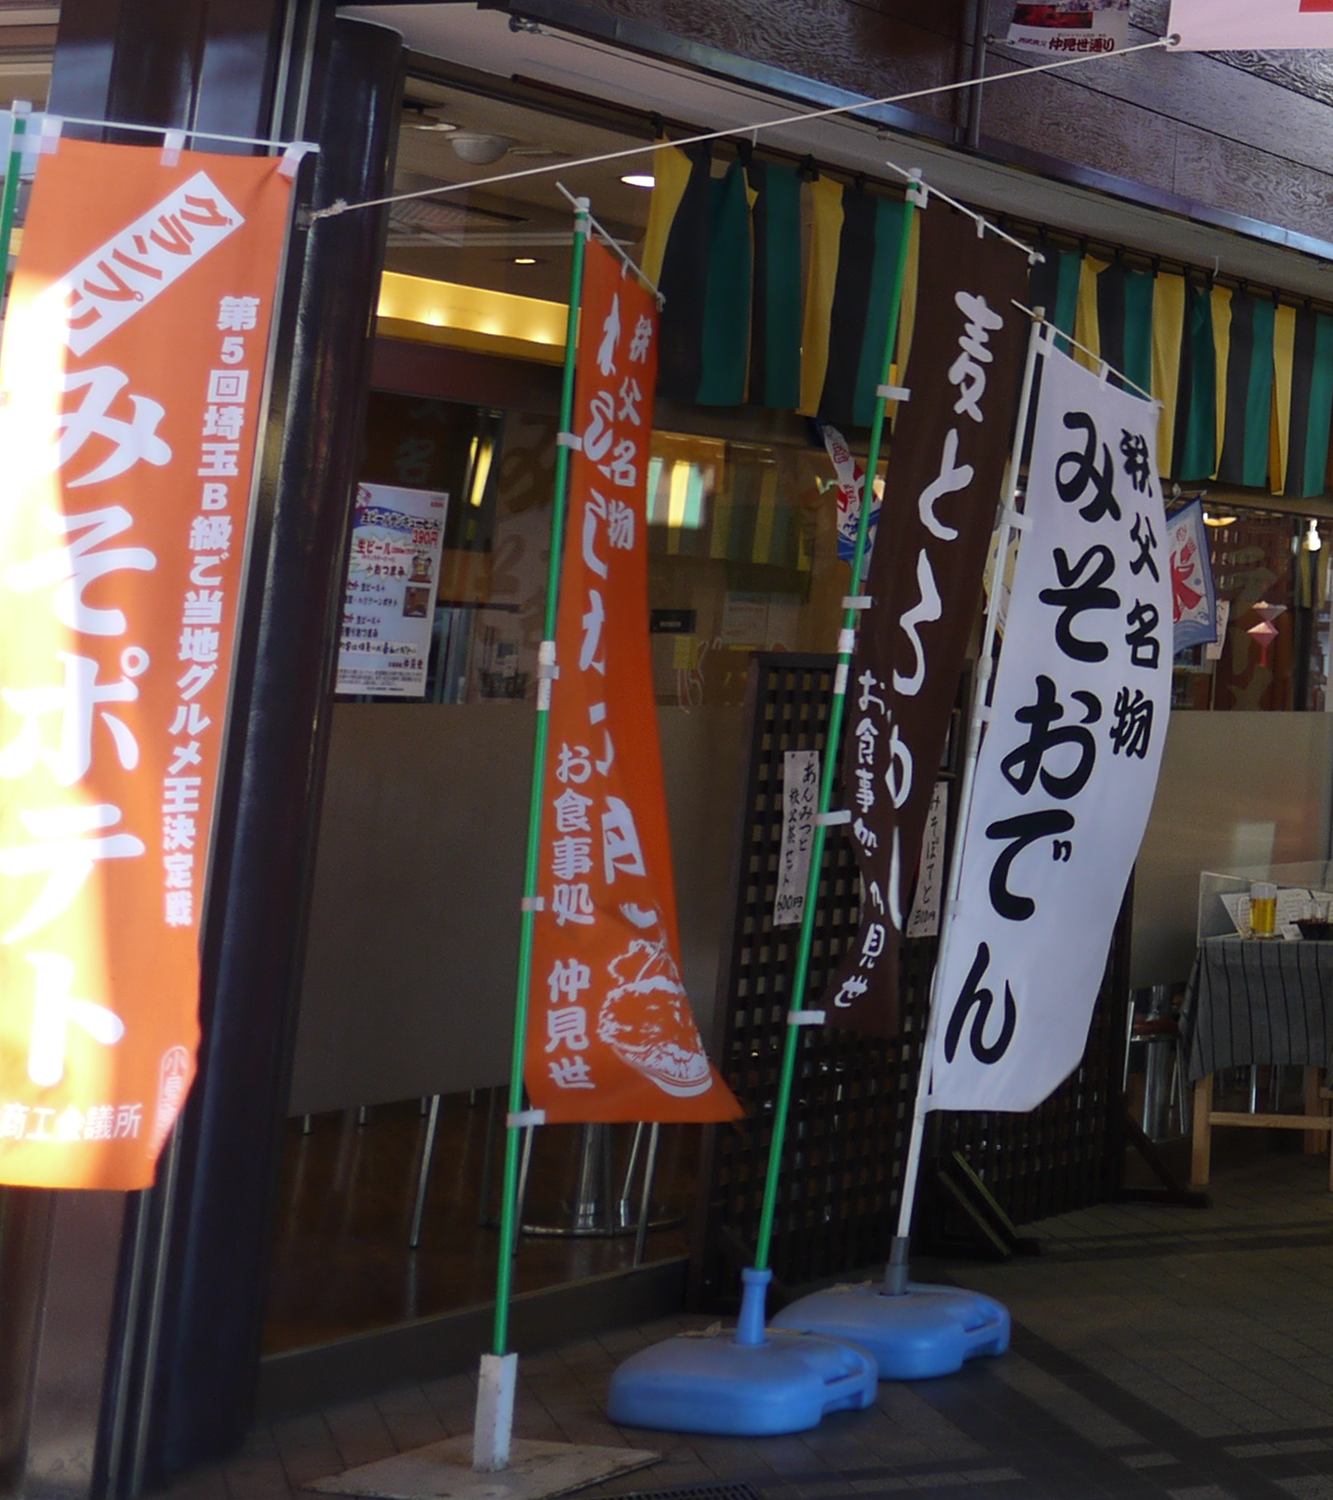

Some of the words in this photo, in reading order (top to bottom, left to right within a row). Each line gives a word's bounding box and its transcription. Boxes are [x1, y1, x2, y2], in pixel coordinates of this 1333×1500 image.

[1049, 37, 1114, 52] 仲見世通り
[1110, 427, 1161, 760] 秩父名物
[944, 410, 1123, 1066] みそおでん
[551, 742, 596, 927] お食事処
[544, 957, 597, 1091] 仲見世
